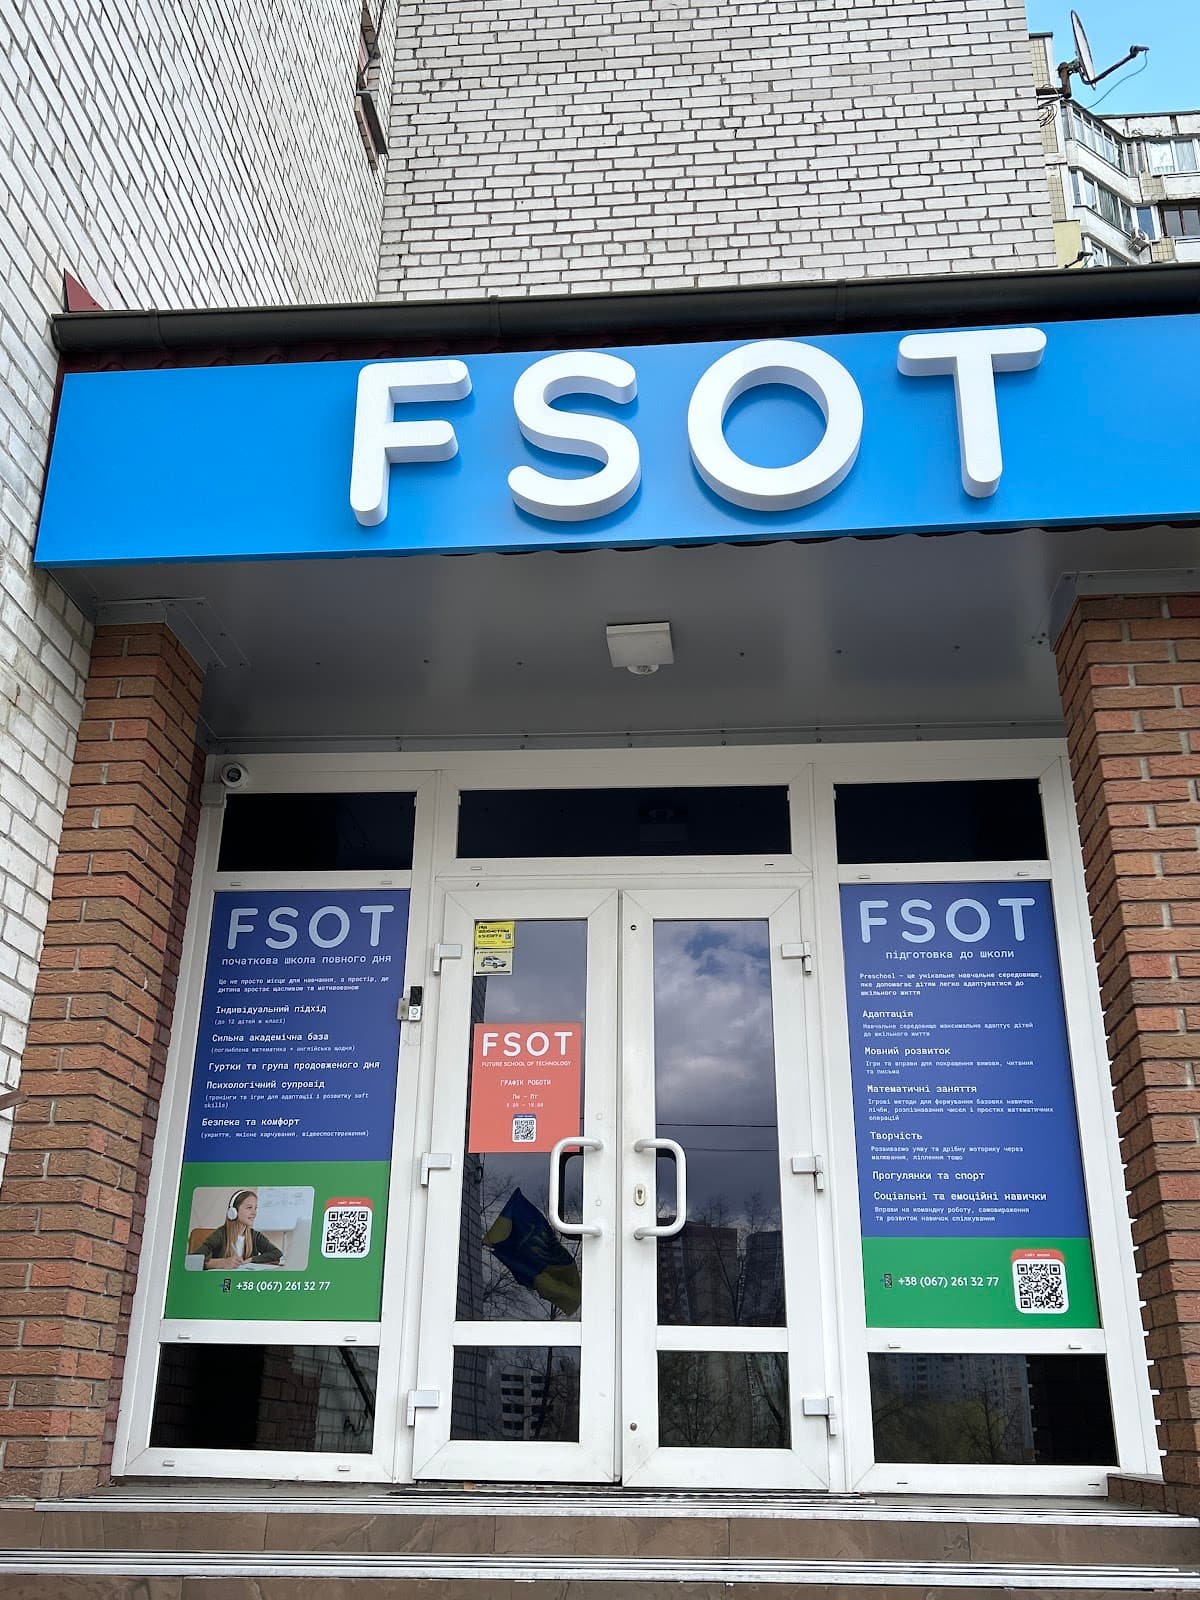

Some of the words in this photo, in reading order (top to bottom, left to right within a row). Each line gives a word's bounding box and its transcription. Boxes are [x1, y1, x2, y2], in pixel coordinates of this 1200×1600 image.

[349, 326, 1046, 527] FSOT
[860, 898, 1035, 943] FSOT
[228, 905, 394, 949] FSOT
[222, 957, 278, 965] початкова
[322, 956, 366, 964] повного
[372, 955, 391, 963] дня
[886, 951, 952, 960] підготовка
[960, 951, 973, 959] до
[981, 950, 1014, 958] школи
[216, 1005, 289, 1014] Індивідуальний
[294, 1005, 326, 1013] підхід
[863, 1010, 913, 1018] Адаптація
[212, 1034, 244, 1042] Сильна
[250, 1034, 302, 1042] академічна
[482, 1032, 573, 1056] FSOT
[865, 1047, 899, 1055] Мовний
[905, 1048, 950, 1056] розвиток
[209, 1062, 240, 1072] Гуртки
[262, 1062, 288, 1071] група
[294, 1062, 358, 1070] продовженого
[207, 1081, 276, 1089] Психологічний
[282, 1080, 324, 1088] супровід
[867, 1085, 930, 1093] Математичні
[202, 1118, 240, 1126] Безпека
[262, 1118, 300, 1126] комфорт
[870, 1131, 923, 1141] Творчість
[873, 1171, 932, 1181] Прогулянки
[937, 1172, 949, 1180] та
[955, 1172, 985, 1181] спорт
[874, 1192, 927, 1201] Соціальні
[951, 1192, 998, 1201] емоційні
[237, 1281, 253, 1290] +38
[256, 1281, 282, 1292] (067)
[285, 1281, 300, 1290] 261
[304, 1281, 315, 1290] 32
[319, 1281, 330, 1290] 77
[898, 1277, 917, 1286] +38
[920, 1277, 948, 1288] (067)
[951, 1277, 968, 1286] 261
[971, 1277, 984, 1286] 32
[987, 1277, 999, 1286] 77
